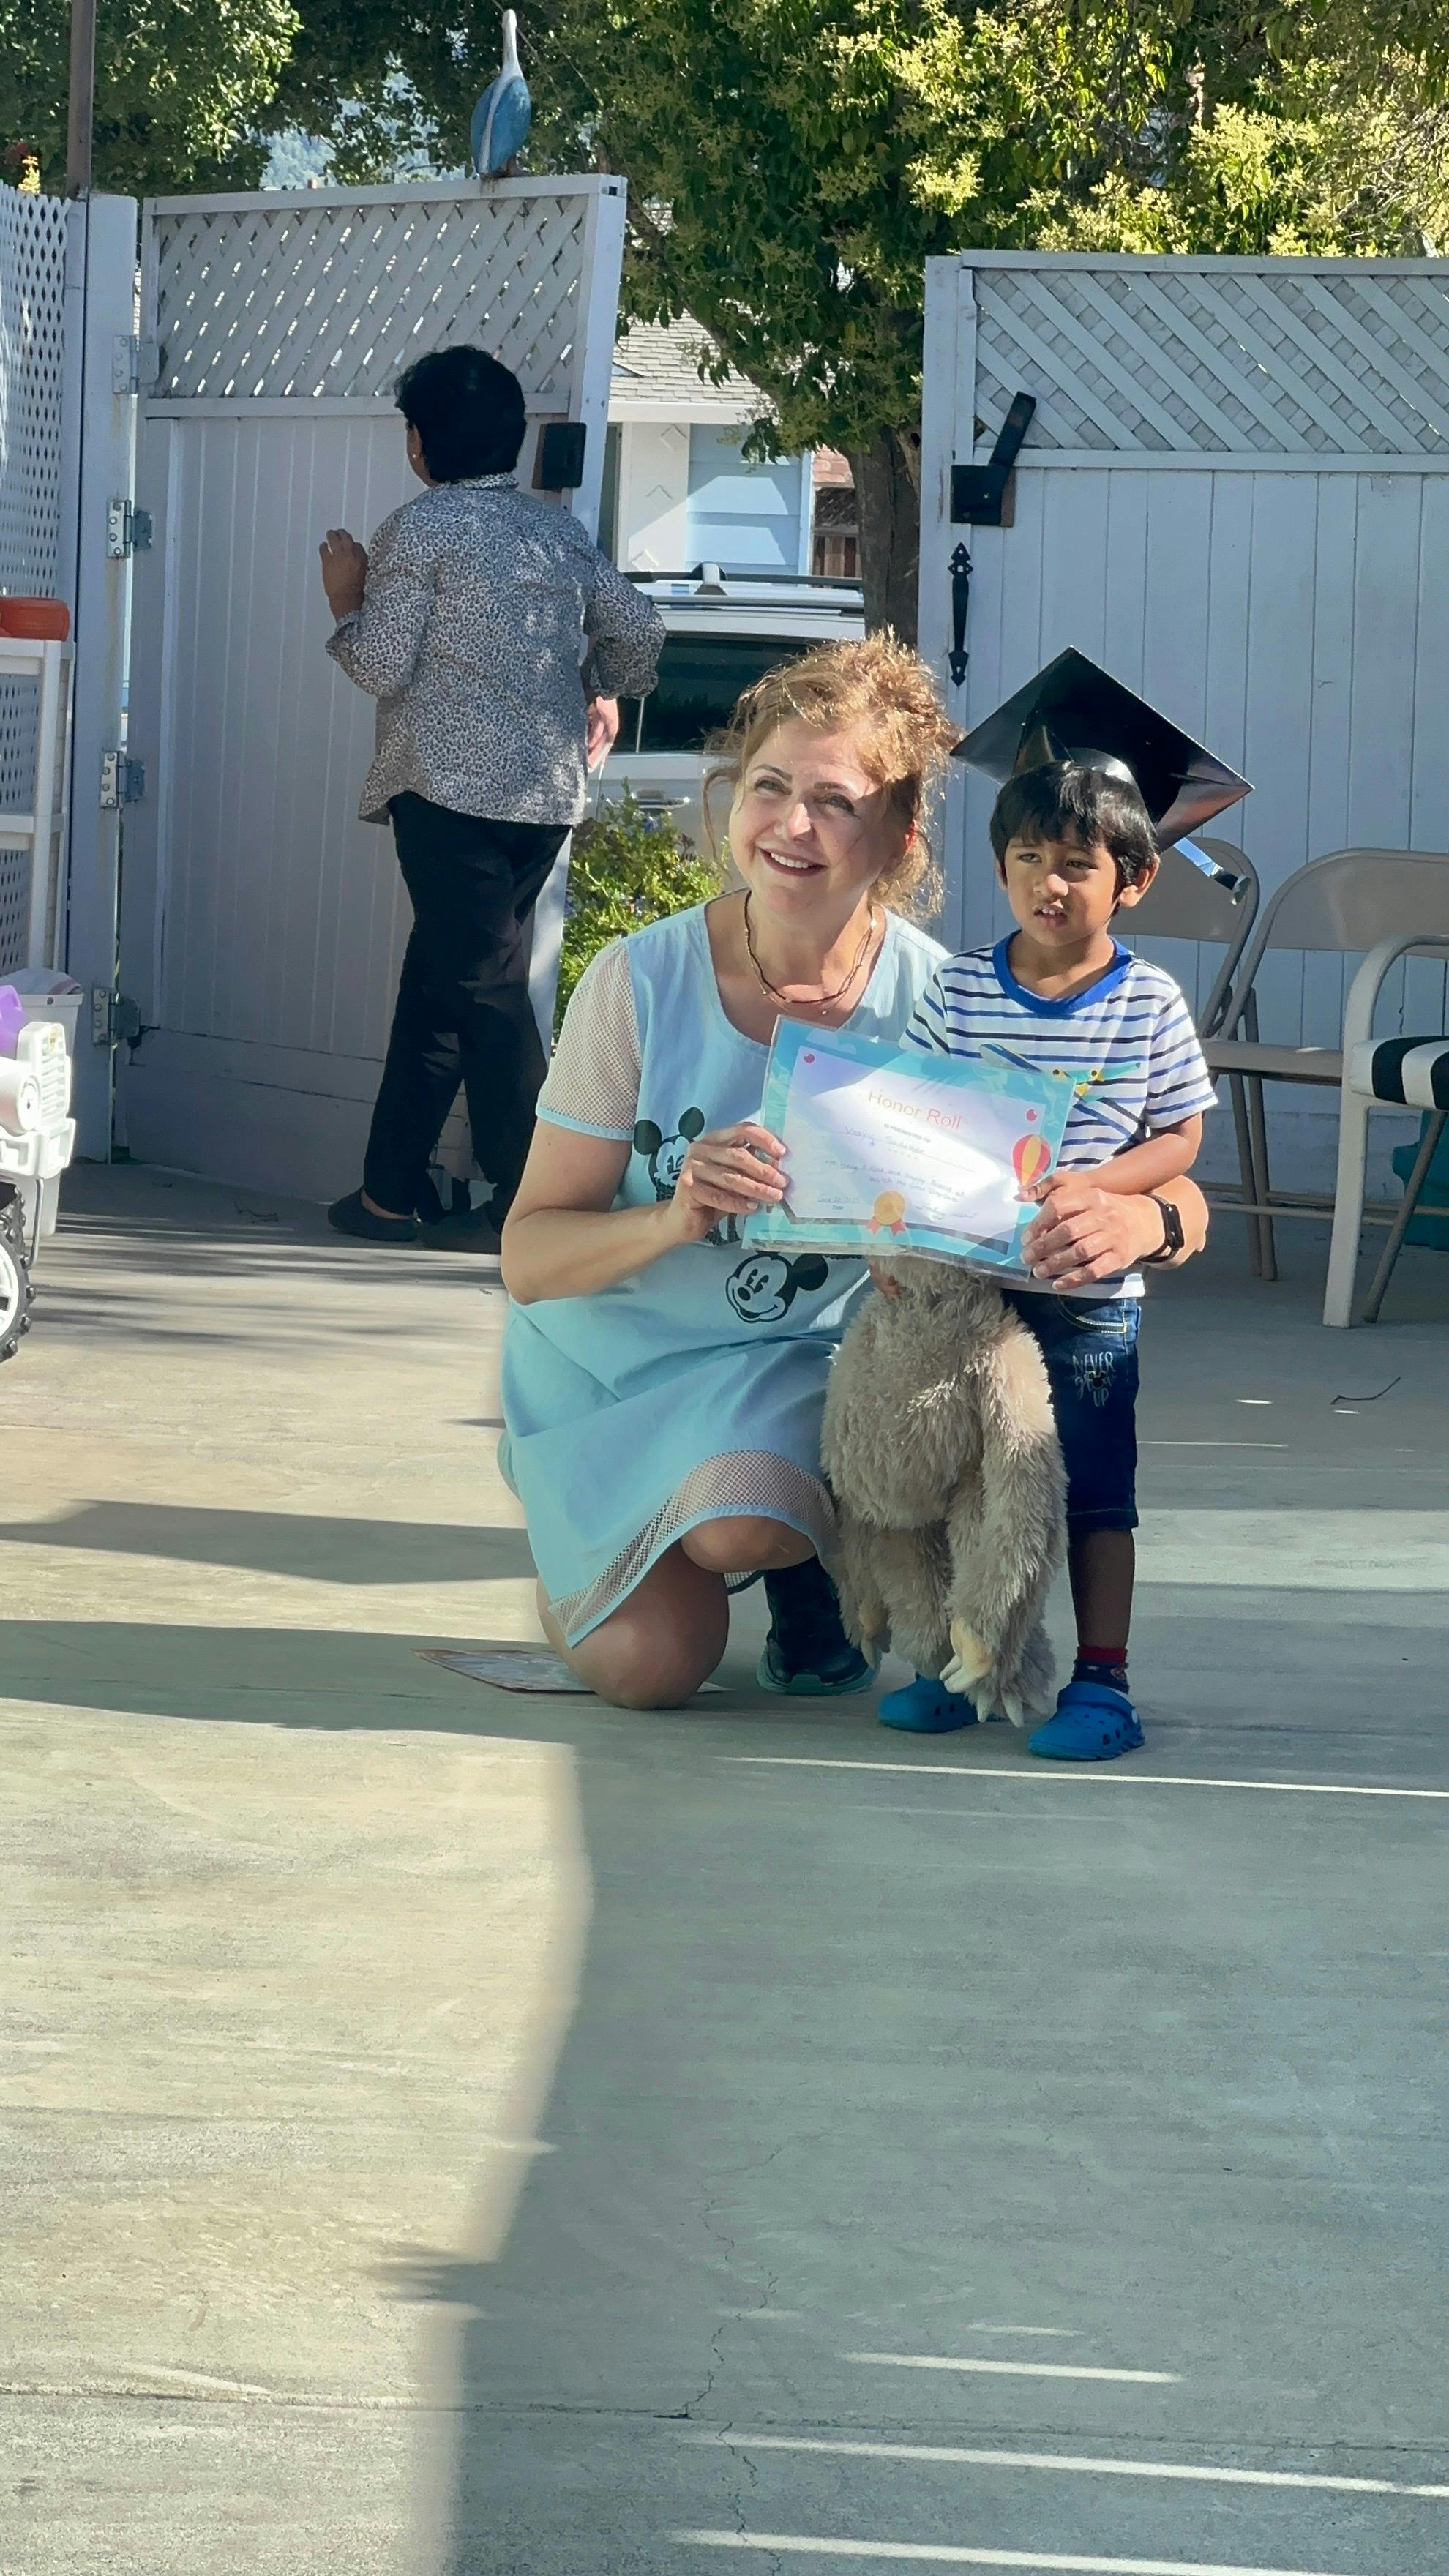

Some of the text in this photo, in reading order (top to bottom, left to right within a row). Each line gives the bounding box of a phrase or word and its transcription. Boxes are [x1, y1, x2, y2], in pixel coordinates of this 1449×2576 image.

[868, 1090, 962, 1131] Honor Roll
[1072, 1351, 1117, 1374] NEVER
[1093, 1387, 1109, 1407] UP
